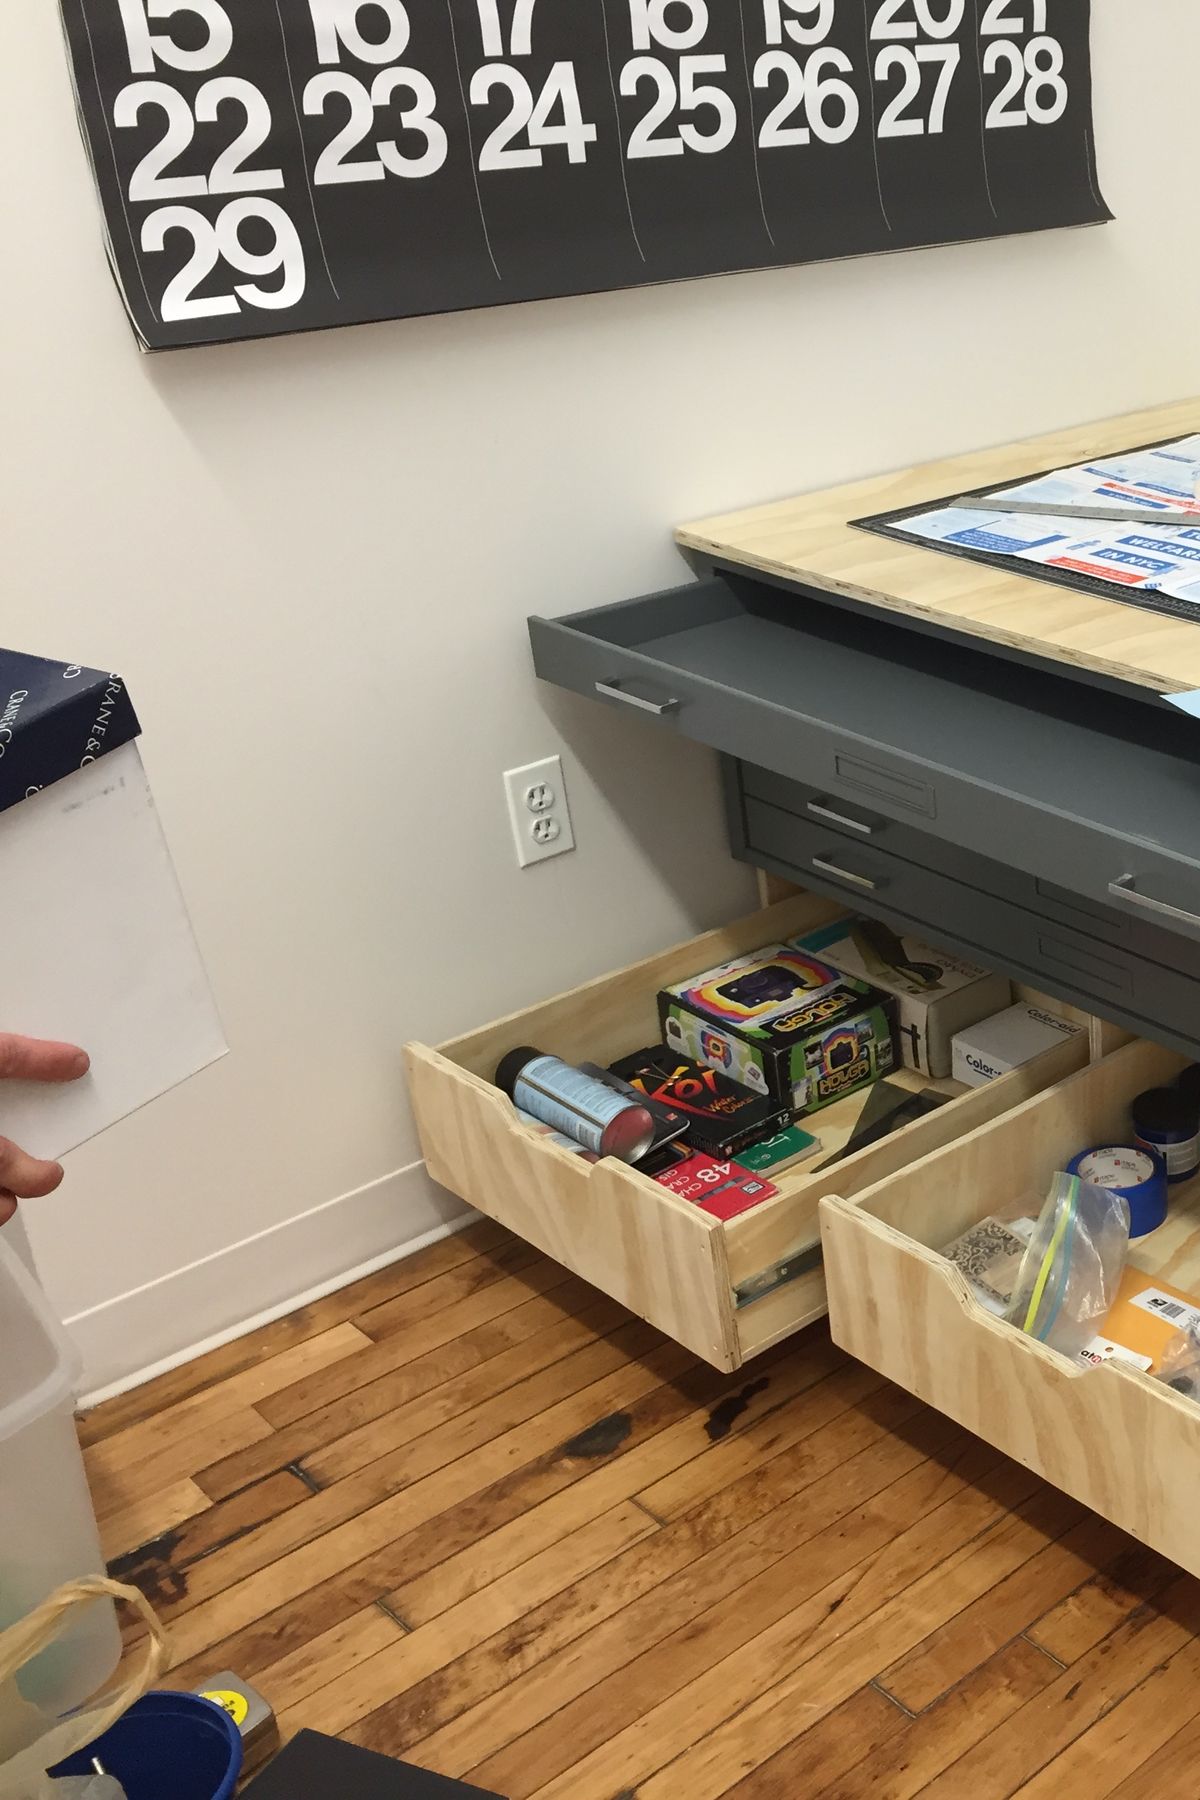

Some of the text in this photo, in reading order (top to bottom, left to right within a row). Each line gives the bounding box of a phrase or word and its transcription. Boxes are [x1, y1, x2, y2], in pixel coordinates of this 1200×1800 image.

[113, 36, 1068, 202] 22 23 24 25 26 27 28
[140, 196, 306, 322] 29
[1099, 550, 1122, 562] IN
[1122, 555, 1165, 570] NYC
[772, 992, 857, 1032] HOLGA
[1027, 1008, 1081, 1034] Color-aid
[819, 1059, 870, 1095] HOLGA
[776, 1112, 791, 1125] 12
[696, 1162, 731, 1184] 48
